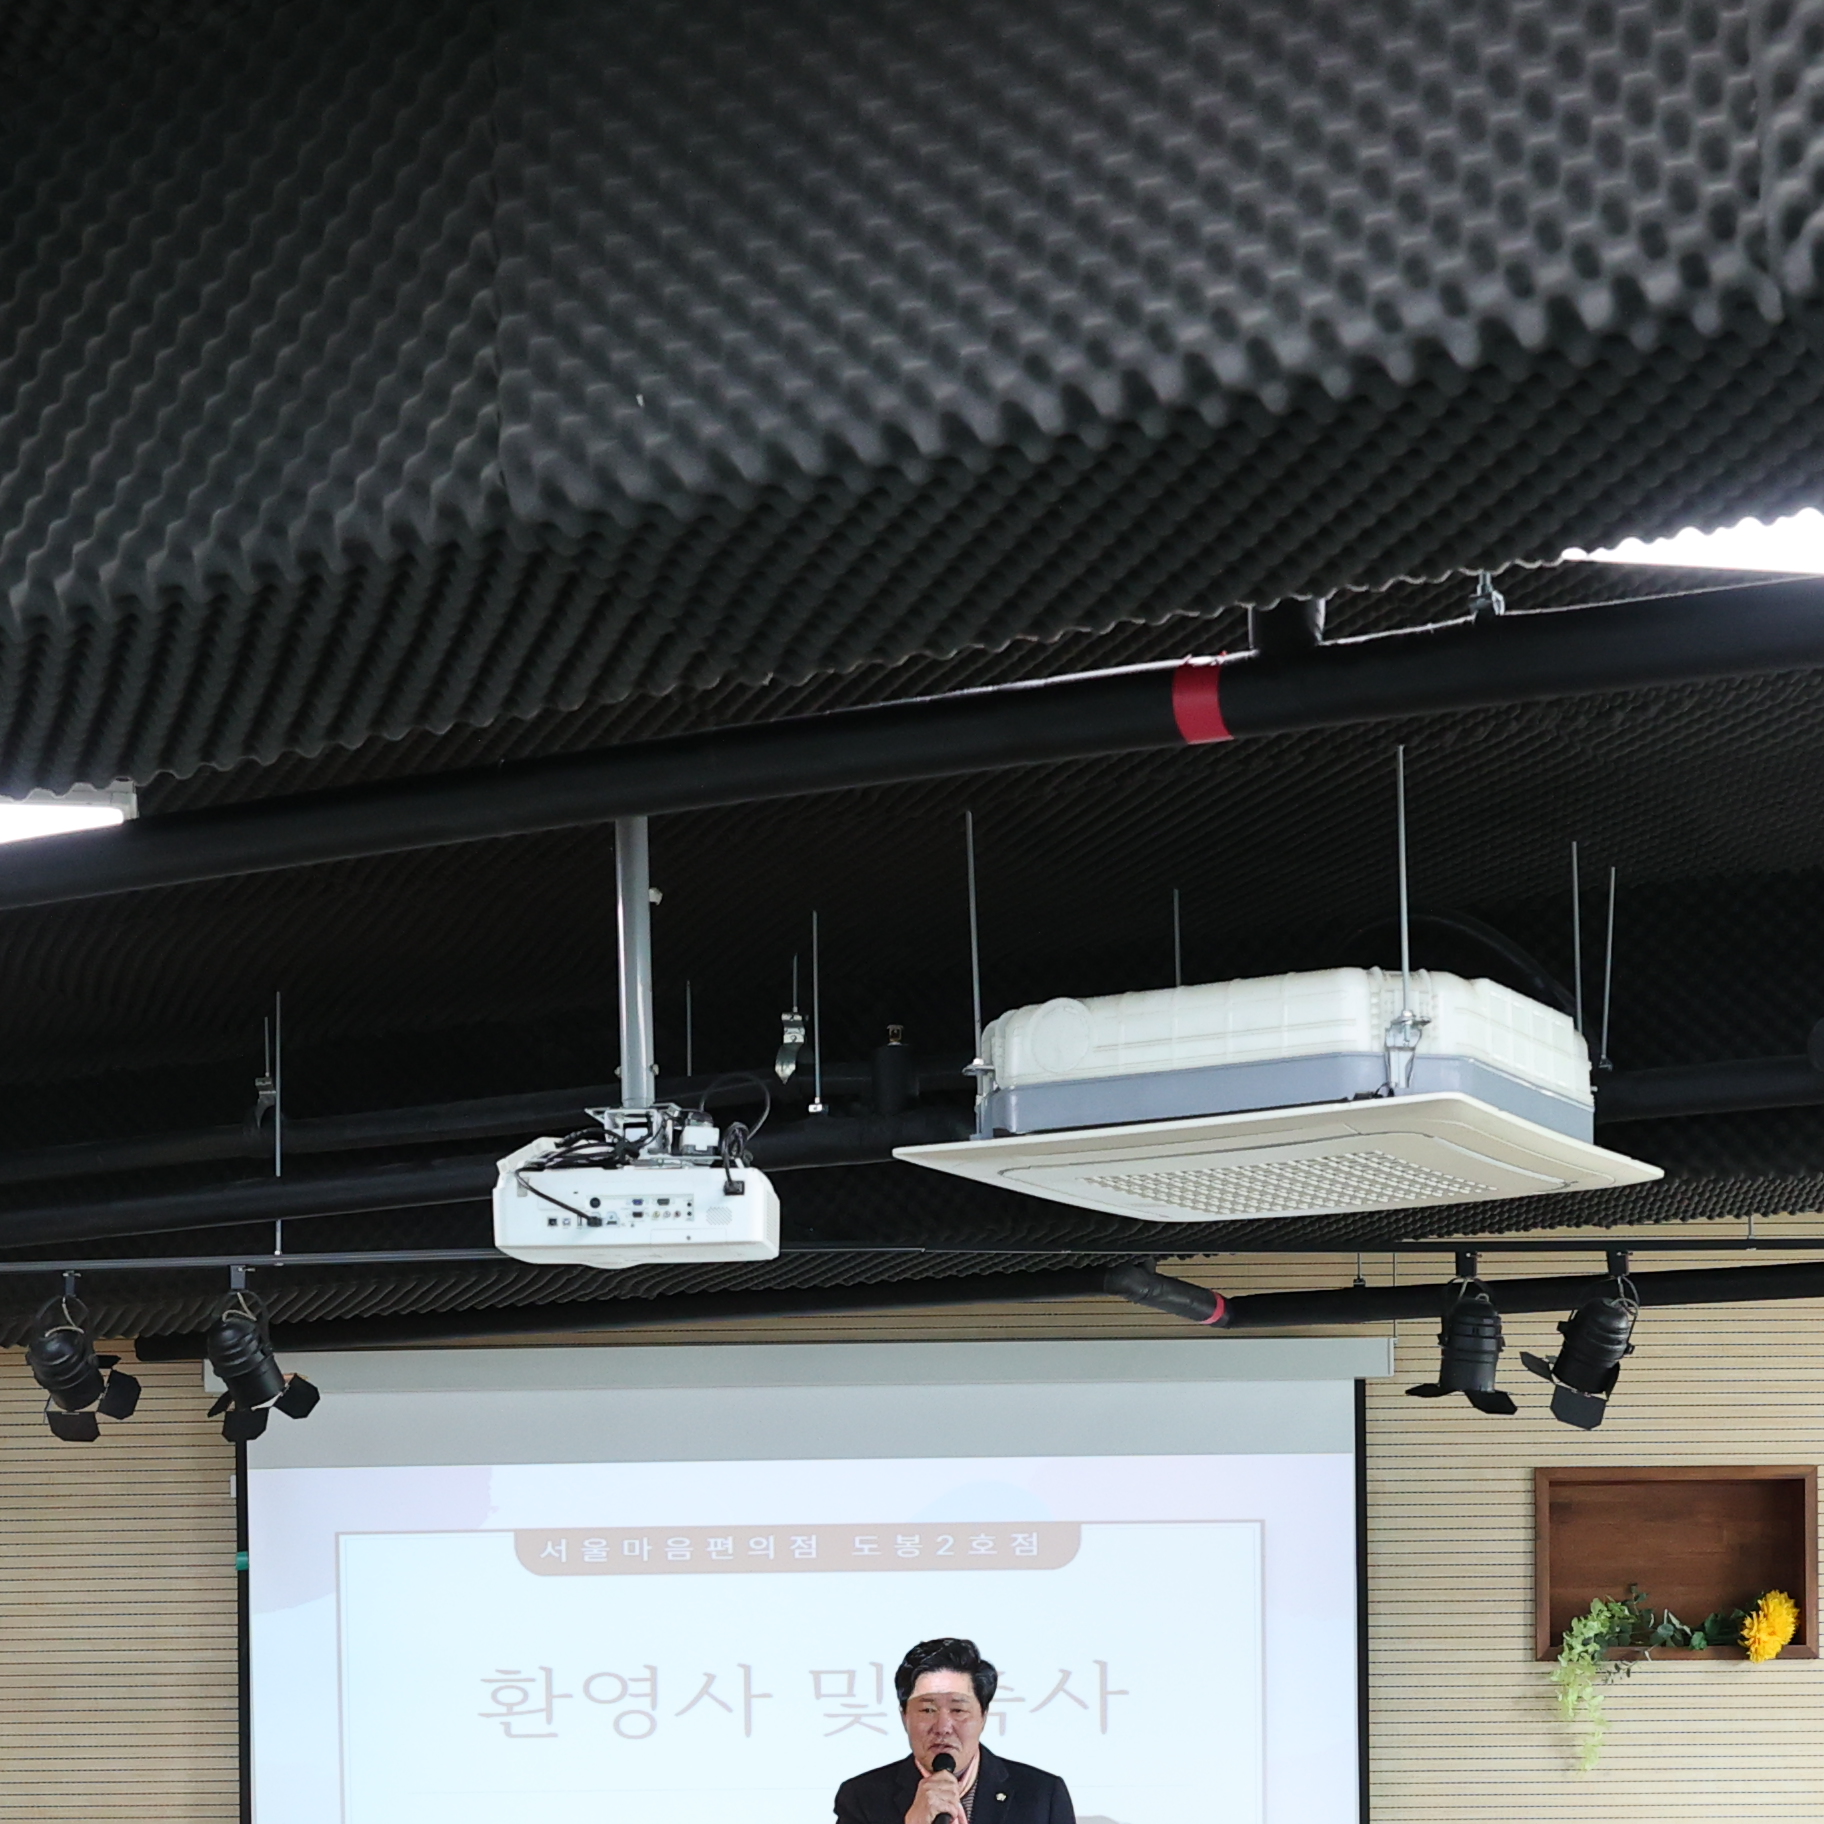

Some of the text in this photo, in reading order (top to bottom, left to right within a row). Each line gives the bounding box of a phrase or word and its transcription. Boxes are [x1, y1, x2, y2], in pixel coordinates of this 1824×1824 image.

[540, 1531, 1041, 1563] 서울마음편의점 도봉2호점
[476, 1659, 1130, 1741] 환영사 및 사
